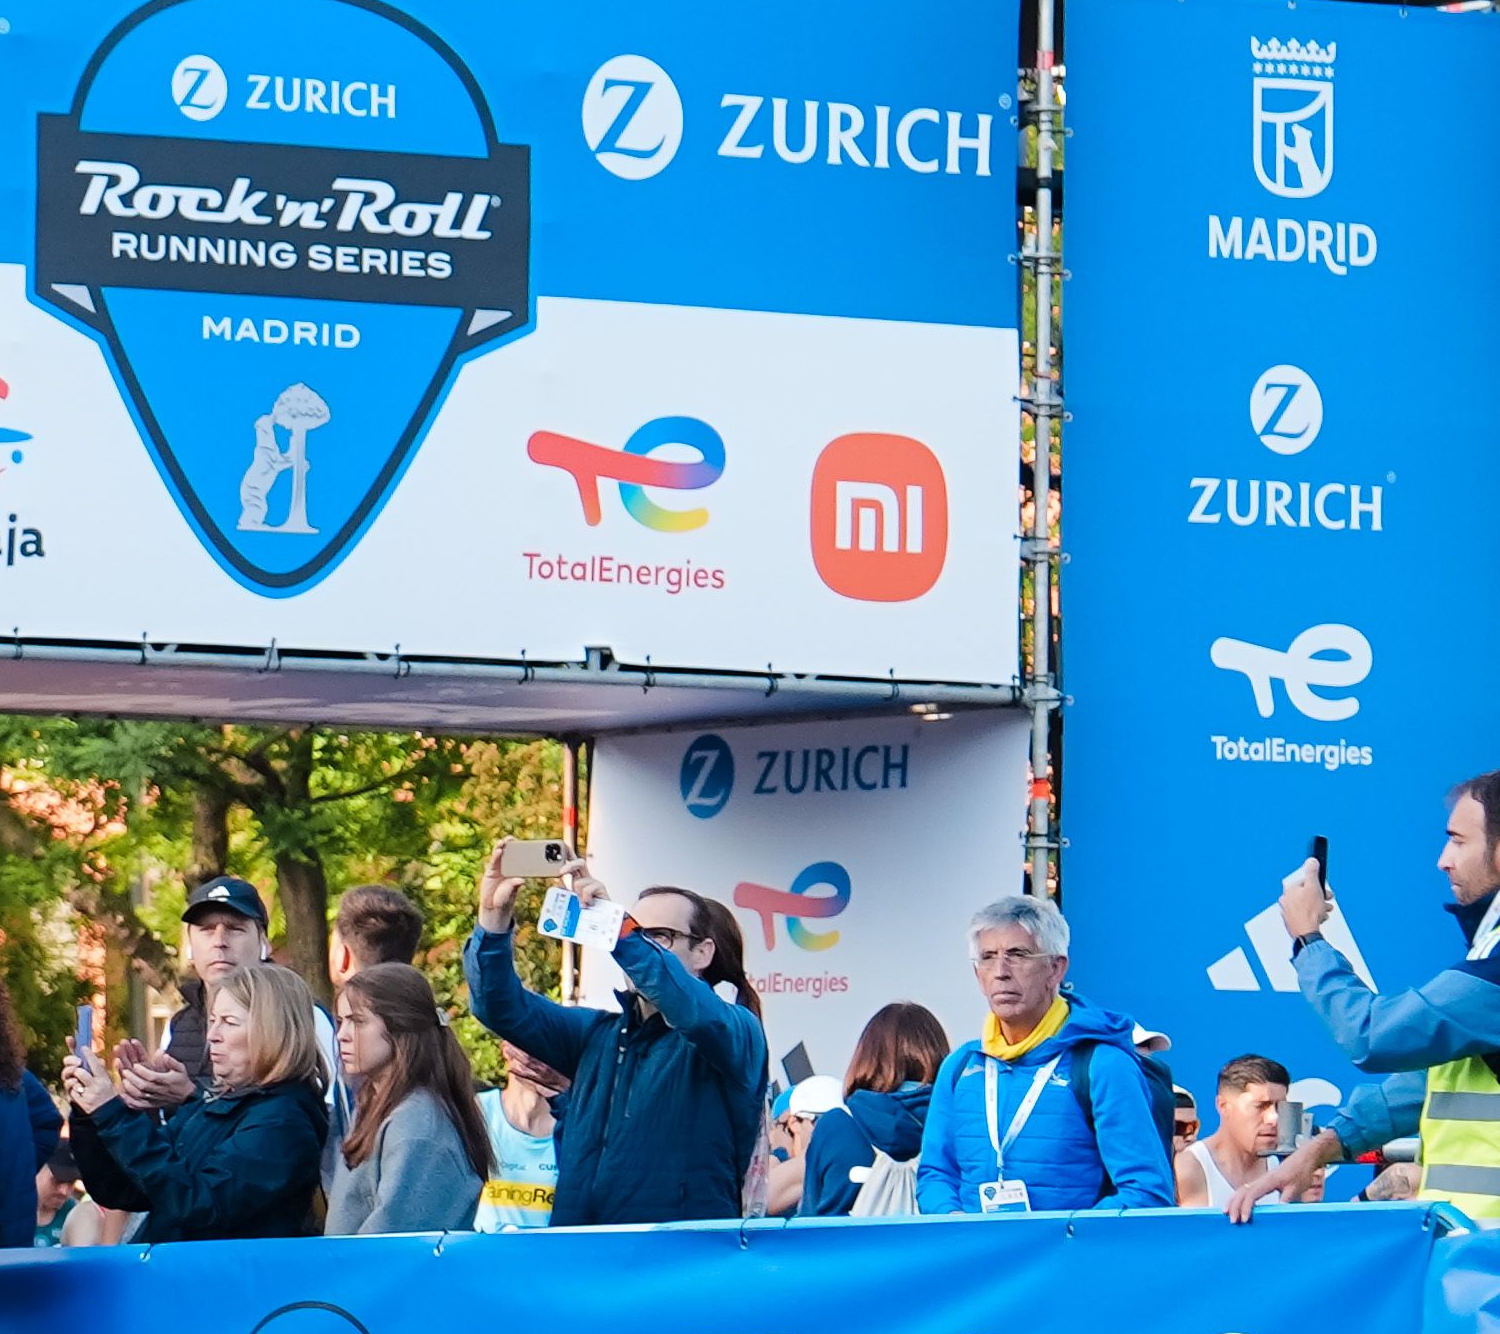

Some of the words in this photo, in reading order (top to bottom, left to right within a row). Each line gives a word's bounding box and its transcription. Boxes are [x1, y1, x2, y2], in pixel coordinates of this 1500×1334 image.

[245, 73, 398, 120] ZURICH
[717, 92, 994, 177] ZURICH
[111, 231, 298, 270] RUNNING
[306, 246, 454, 280] SERIES
[1207, 213, 1378, 276] MADRID
[201, 315, 361, 350] MADRID
[1187, 476, 1384, 532] ZURICH
[522, 552, 726, 595] TotalEnergies
[753, 743, 910, 796] ZURICH
[1210, 733, 1373, 772] TotalEnergies
